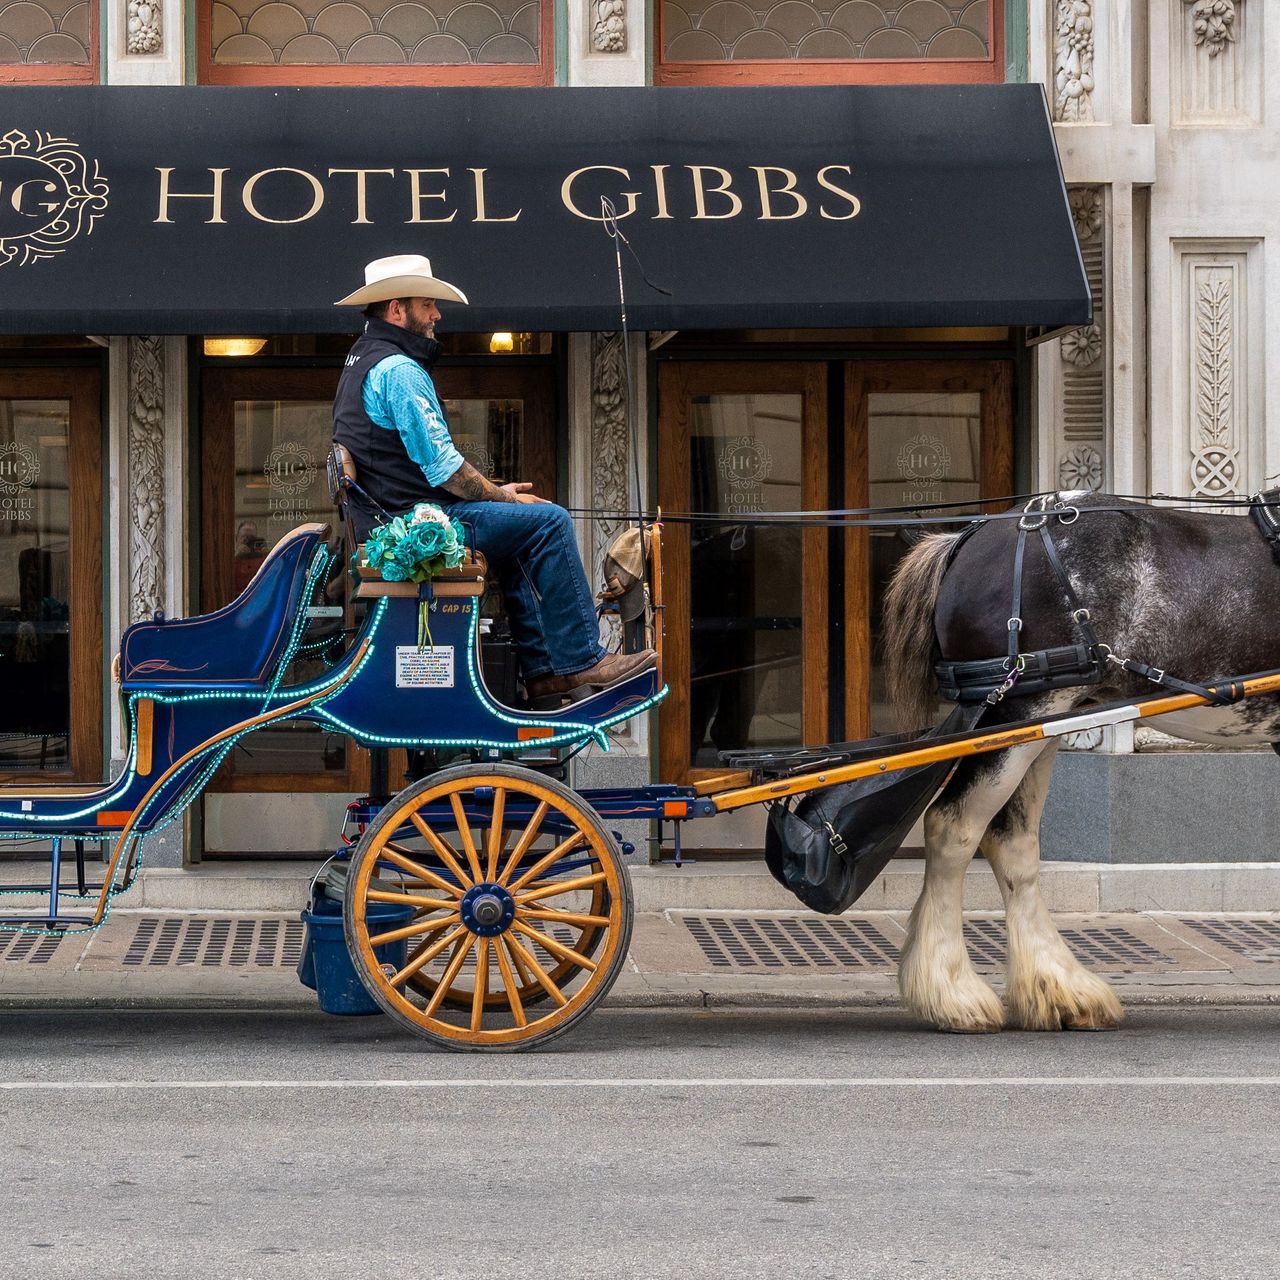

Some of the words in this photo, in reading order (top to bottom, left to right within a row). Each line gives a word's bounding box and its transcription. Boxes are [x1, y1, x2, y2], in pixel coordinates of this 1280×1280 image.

[154, 166, 522, 225] HOTEL
[561, 164, 863, 222] GIBBS
[0, 461, 26, 476] HG
[724, 493, 767, 504] HOTEL
[902, 491, 945, 503] HOTEL
[269, 499, 312, 509] HOTEL
[272, 510, 309, 521] GIBBS
[442, 604, 459, 613] CAP
